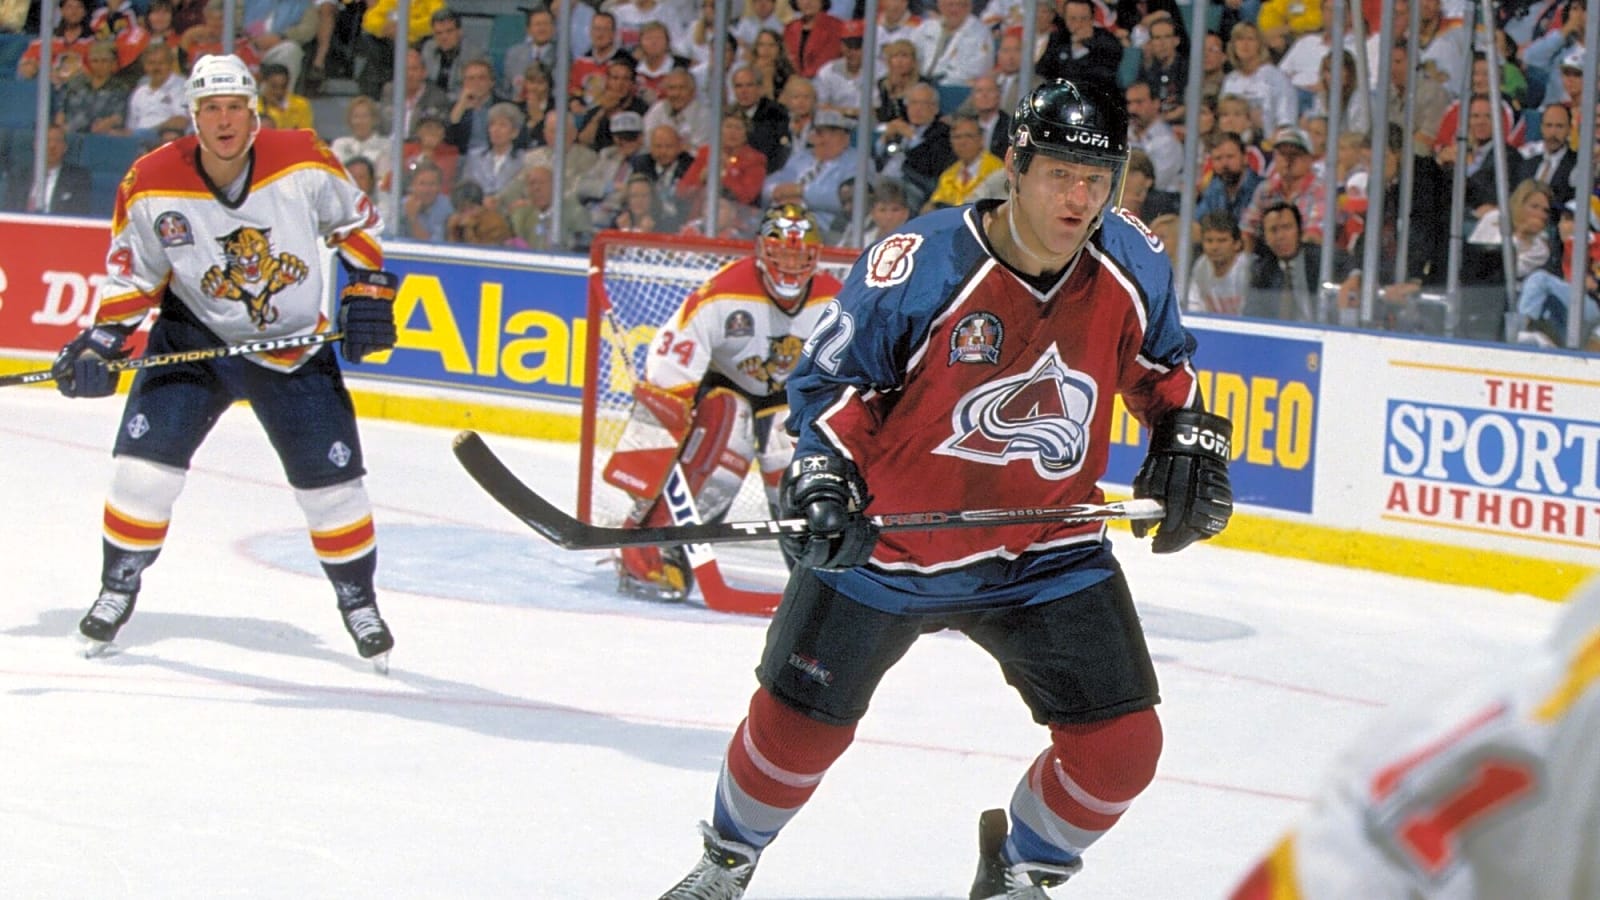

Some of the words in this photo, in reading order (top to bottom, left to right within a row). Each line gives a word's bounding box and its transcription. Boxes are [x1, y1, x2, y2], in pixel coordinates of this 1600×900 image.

[1065, 130, 1109, 149] JOFA
[229, 334, 325, 356] KOHO
[656, 331, 696, 368] 34
[802, 298, 855, 377] 22
[1485, 379, 1554, 413] THE
[1388, 402, 1600, 497] SPORT
[1385, 481, 1600, 538] AUTHORI
